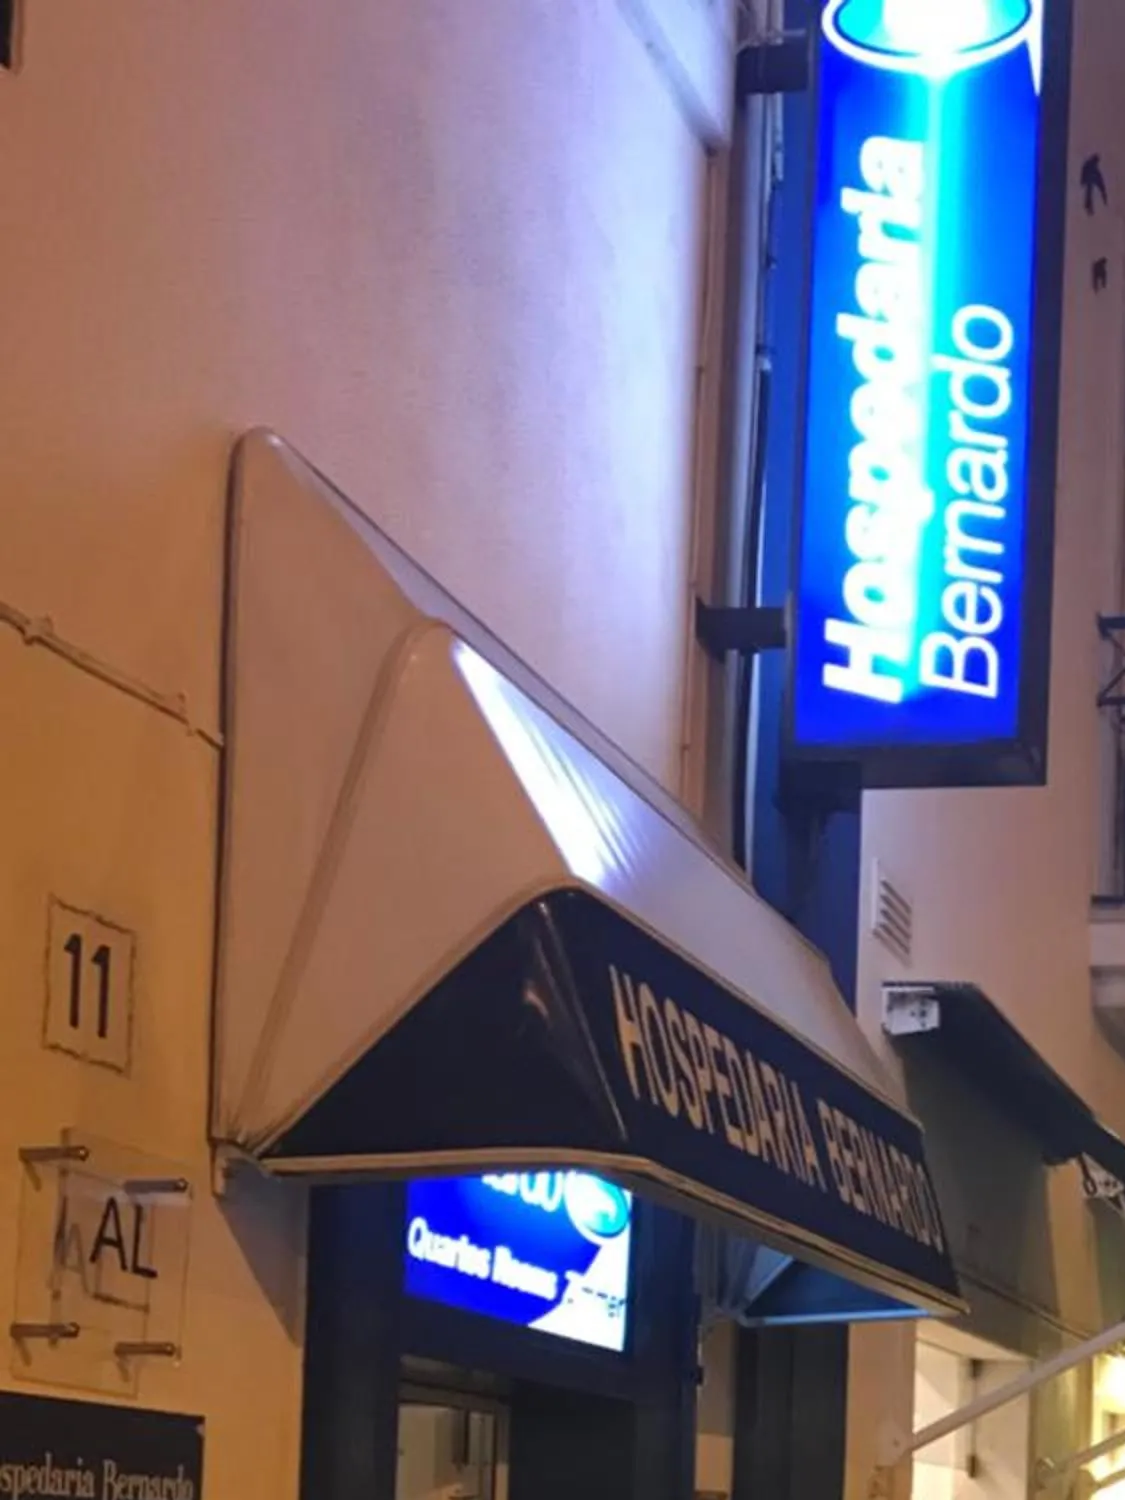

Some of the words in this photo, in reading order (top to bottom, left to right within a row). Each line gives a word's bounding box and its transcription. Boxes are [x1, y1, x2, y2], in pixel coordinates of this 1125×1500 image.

[919, 303, 1014, 699] Bernardo
[63, 932, 111, 1039] 11
[609, 964, 828, 1194] HOSPEDARIA
[817, 1098, 944, 1254] BERNARDO
[89, 1195, 158, 1279] AL
